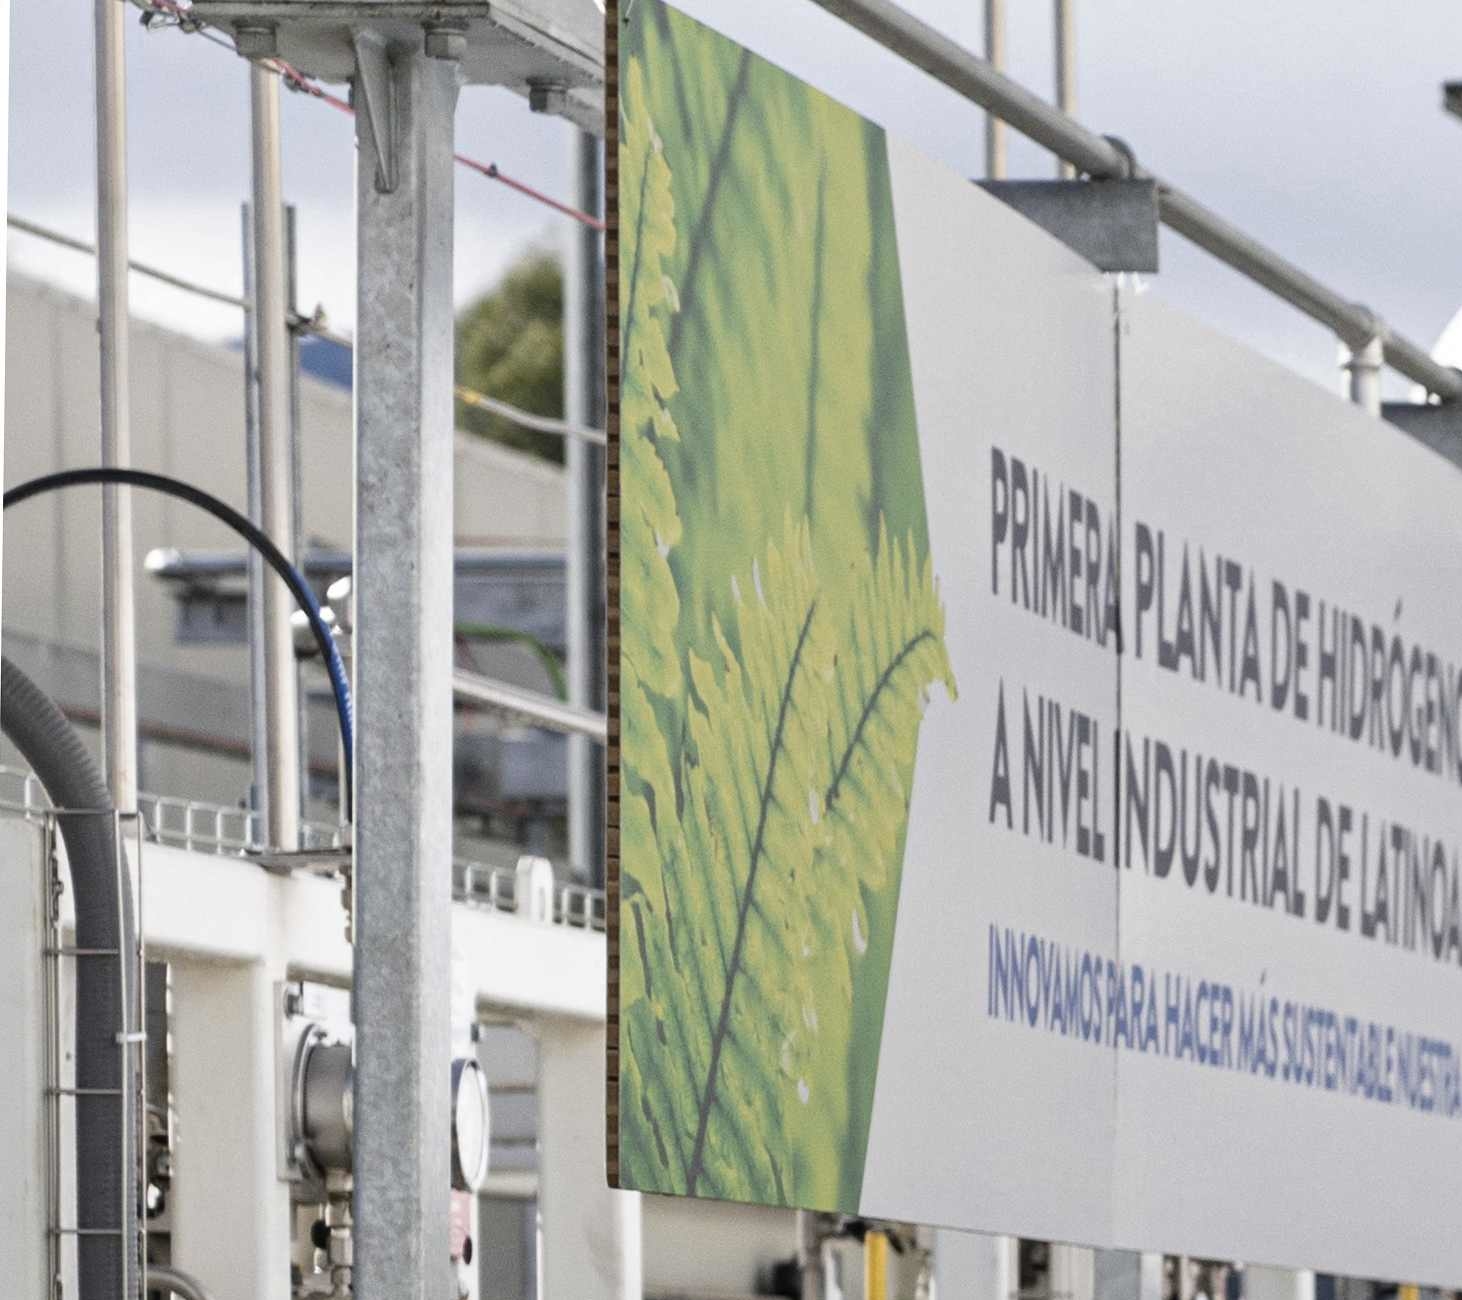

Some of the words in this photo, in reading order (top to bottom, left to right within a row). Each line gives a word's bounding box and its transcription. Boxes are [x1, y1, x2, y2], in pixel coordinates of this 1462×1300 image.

[991, 445, 1124, 654] PRIMERA
[1135, 520, 1262, 704] PLANTA
[1272, 577, 1310, 722] DE
[989, 675, 1013, 830] A
[1023, 686, 1106, 864] NIVEL
[1114, 727, 1304, 919] INDUSTRIAL
[1314, 794, 1353, 931] DE
[988, 921, 1102, 1046] INNOVAMOS
[1106, 957, 1159, 1056] PARA
[1164, 970, 1234, 1068] HACER
[1238, 967, 1278, 1079] MÁS
[1283, 995, 1396, 1103] SUSTENTABLE
[1400, 1028, 1461, 1117] NUESTRA
